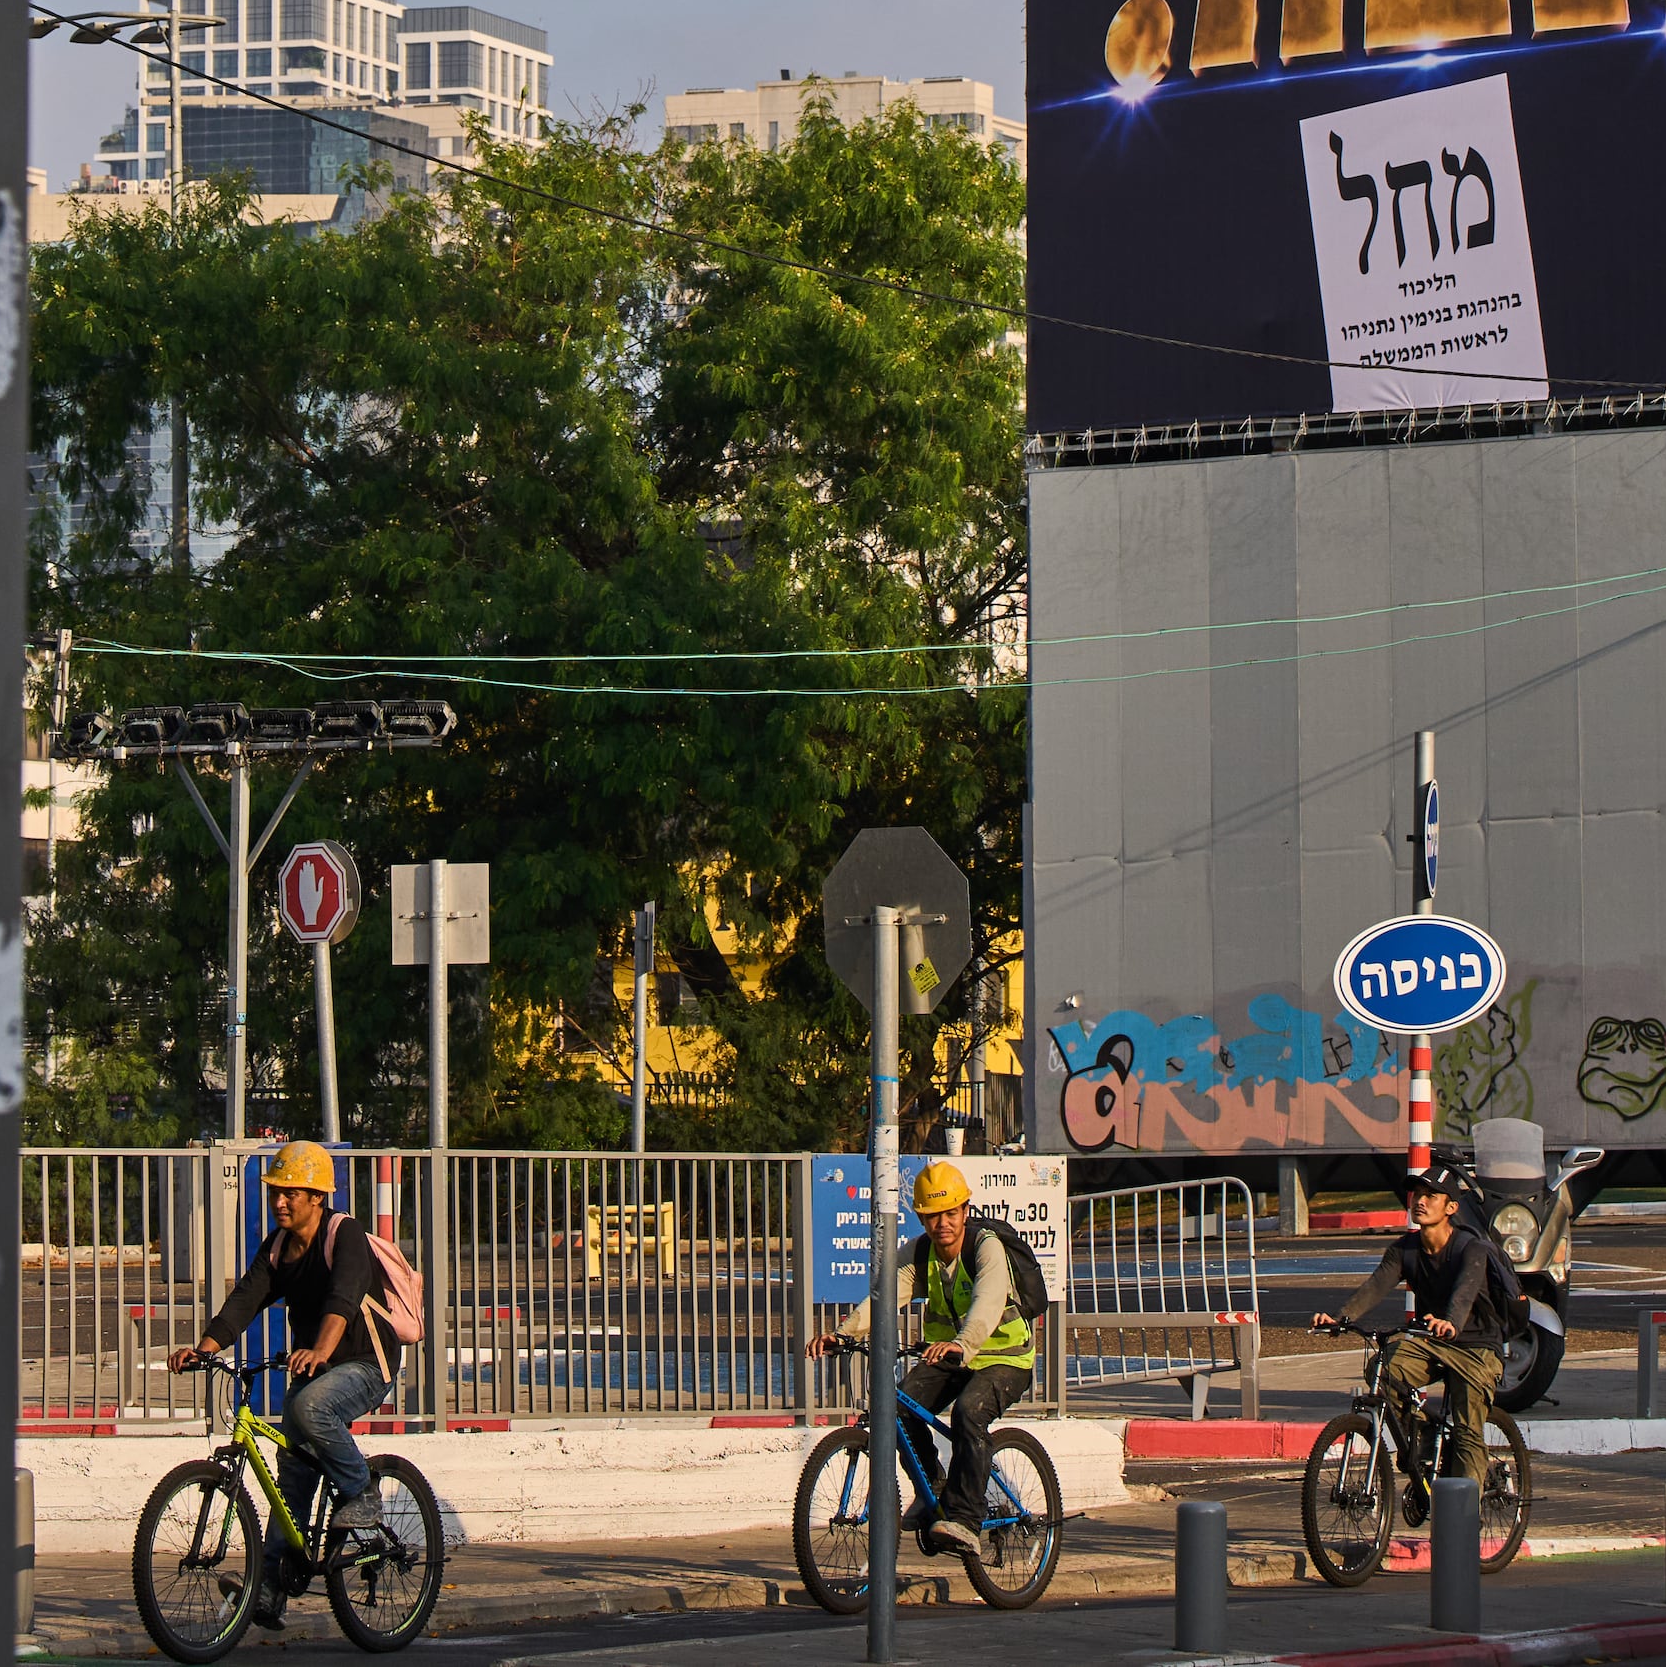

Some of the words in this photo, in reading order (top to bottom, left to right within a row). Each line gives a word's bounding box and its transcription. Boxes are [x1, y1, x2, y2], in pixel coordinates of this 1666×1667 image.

[1329, 130, 1498, 276] מחל
[1398, 273, 1457, 297] הליכוד
[1457, 292, 1522, 319] בהנהגת
[1340, 317, 1396, 341] נתניהו
[1400, 306, 1453, 334] בנימין
[1441, 324, 1509, 355] לראשות
[1359, 342, 1436, 368] הממשלה
[1360, 951, 1483, 1000] כניסה
[981, 1174, 1016, 1190] מחירון:
[836, 1212, 858, 1228] ניתן
